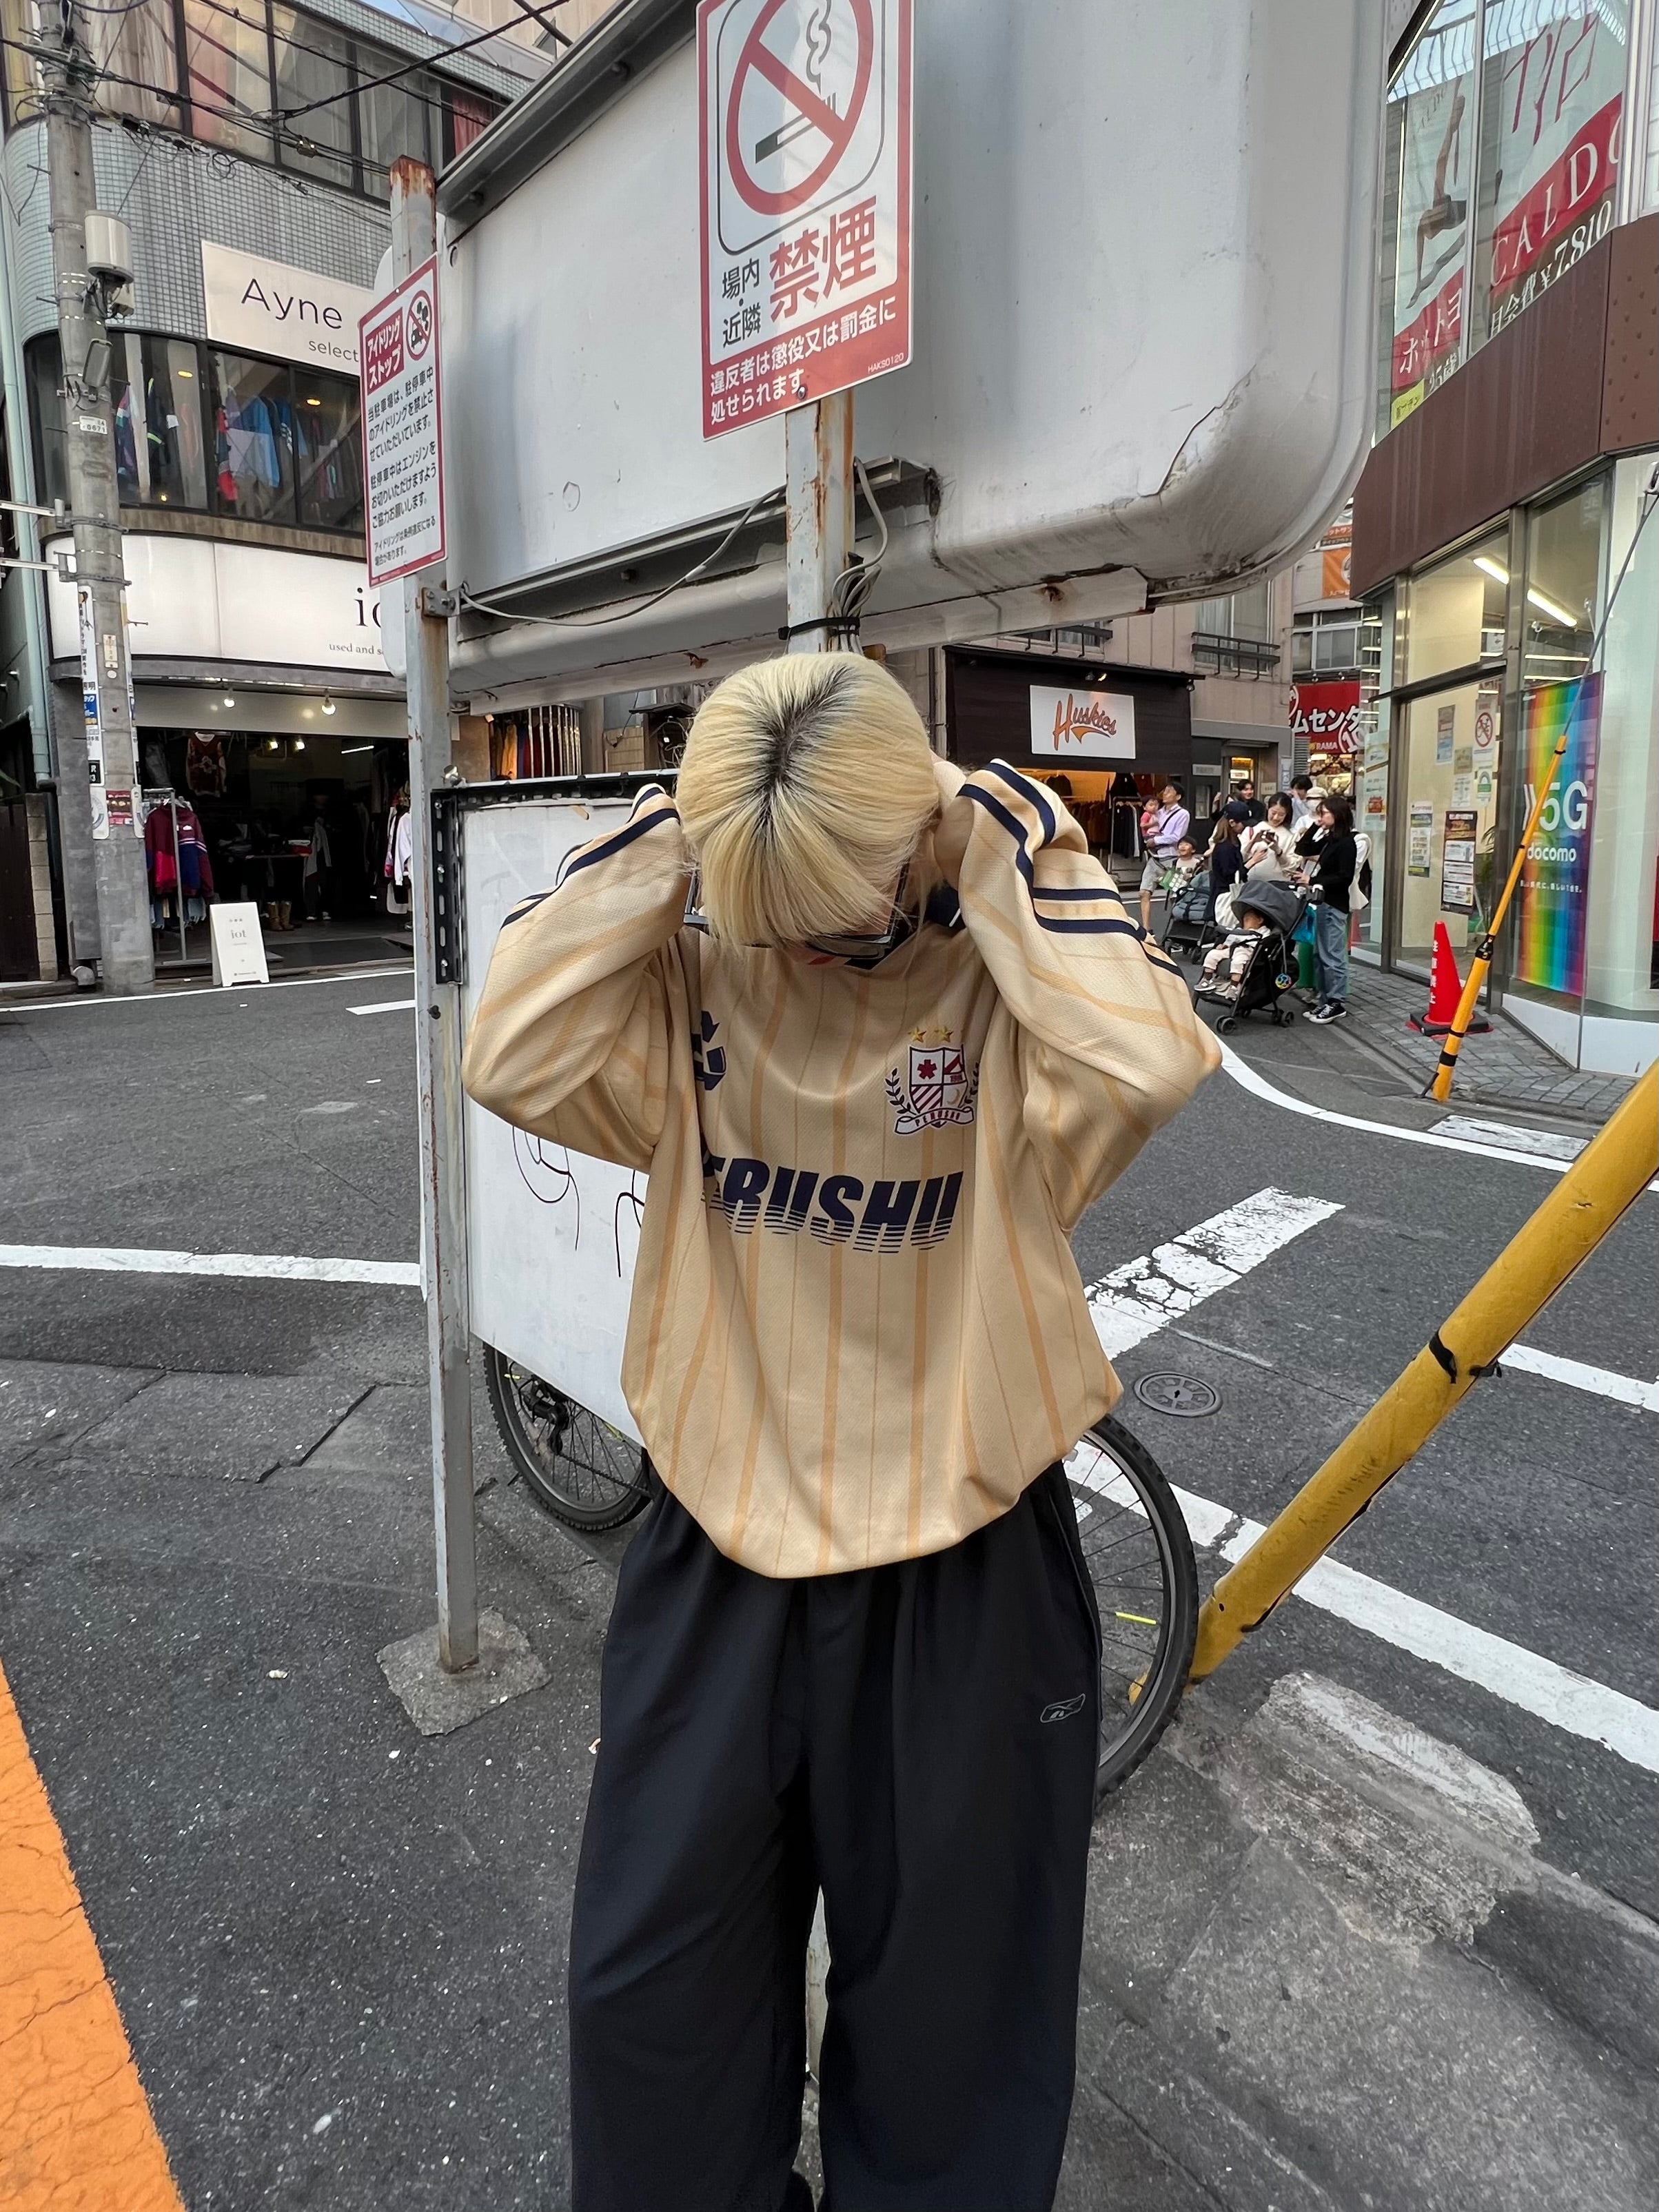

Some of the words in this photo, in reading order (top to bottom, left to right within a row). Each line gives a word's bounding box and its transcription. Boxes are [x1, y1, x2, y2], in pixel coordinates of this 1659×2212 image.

[722, 258, 760, 300] 場内
[769, 195, 877, 322] 禁煙
[241, 278, 342, 329] Ayne
[723, 303, 761, 347] 近隣
[309, 340, 358, 362] select
[367, 315, 400, 362] アイドリング
[711, 296, 896, 396] 違反者は懲役又は罰金に
[369, 344, 401, 389] ストップ
[368, 365, 434, 422] 当駐車場は、駐停車中
[369, 388, 434, 441] のアイドリングを禁止さ
[711, 368, 805, 425] 処せられます
[369, 414, 431, 462] せていただいています。
[371, 441, 436, 490] 駐停車中はエンジンを
[372, 462, 436, 509] お切りいただけますよう
[372, 491, 427, 529] ご協力お願いします。
[329, 643, 353, 653] used
[356, 645, 374, 655] and
[1052, 693, 1117, 751] Huskies
[1290, 705, 1363, 734] ムセンタ
[1539, 780, 1588, 831] 5G
[1527, 841, 1576, 862] docomo
